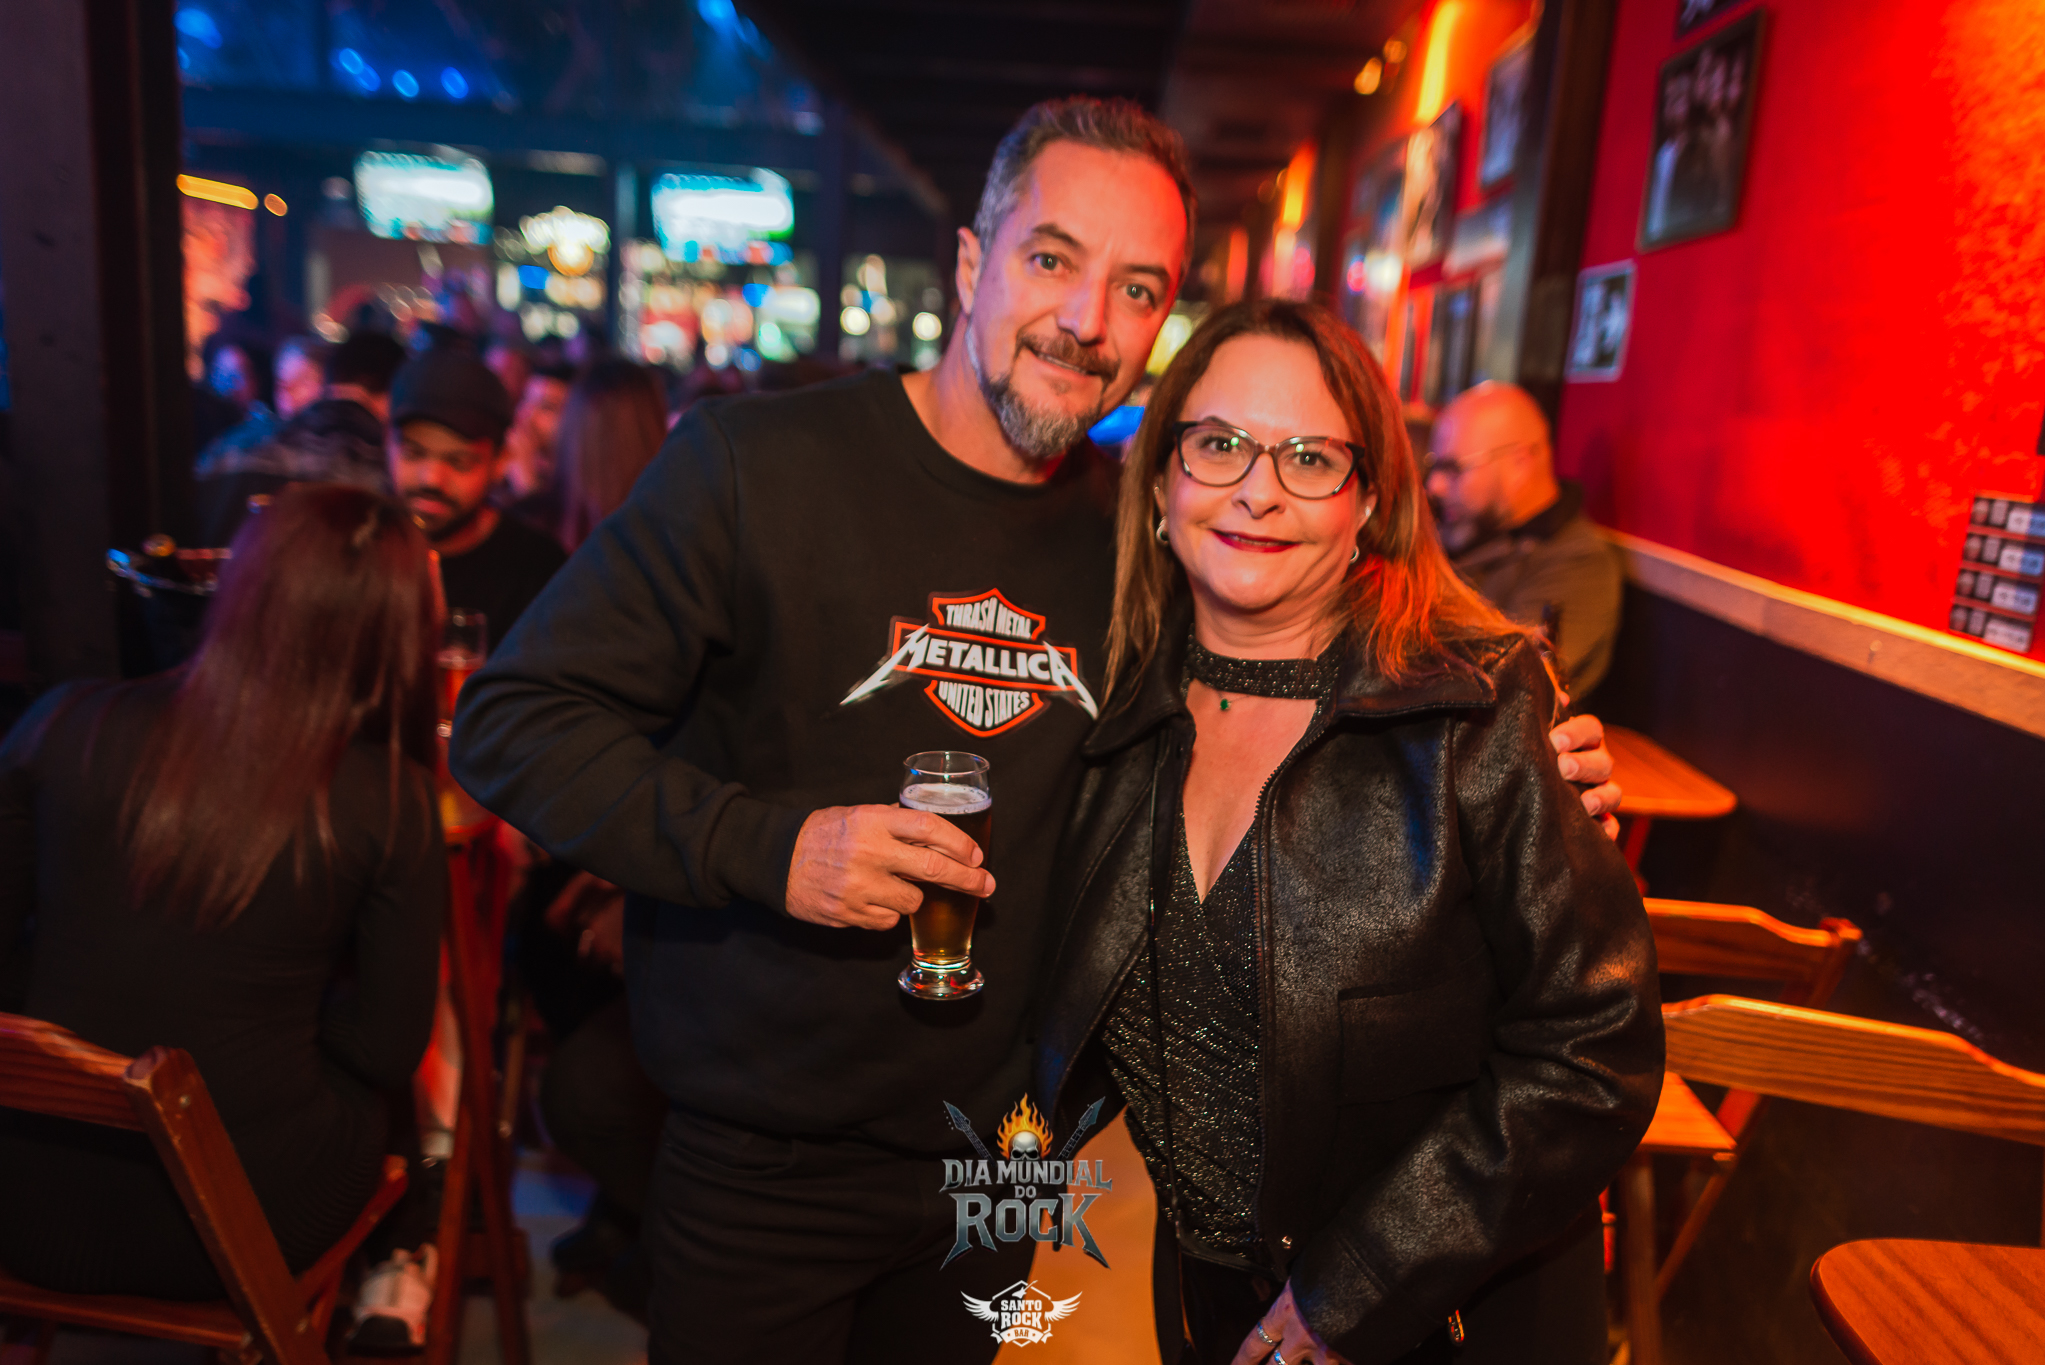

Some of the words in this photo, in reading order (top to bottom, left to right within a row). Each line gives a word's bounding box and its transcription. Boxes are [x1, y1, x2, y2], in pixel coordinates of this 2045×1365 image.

[946, 597, 997, 632] THRASH
[995, 603, 1032, 639] METAL
[839, 623, 1099, 720] METALLICA
[938, 681, 984, 728] UNITED
[984, 687, 1030, 728] STATES
